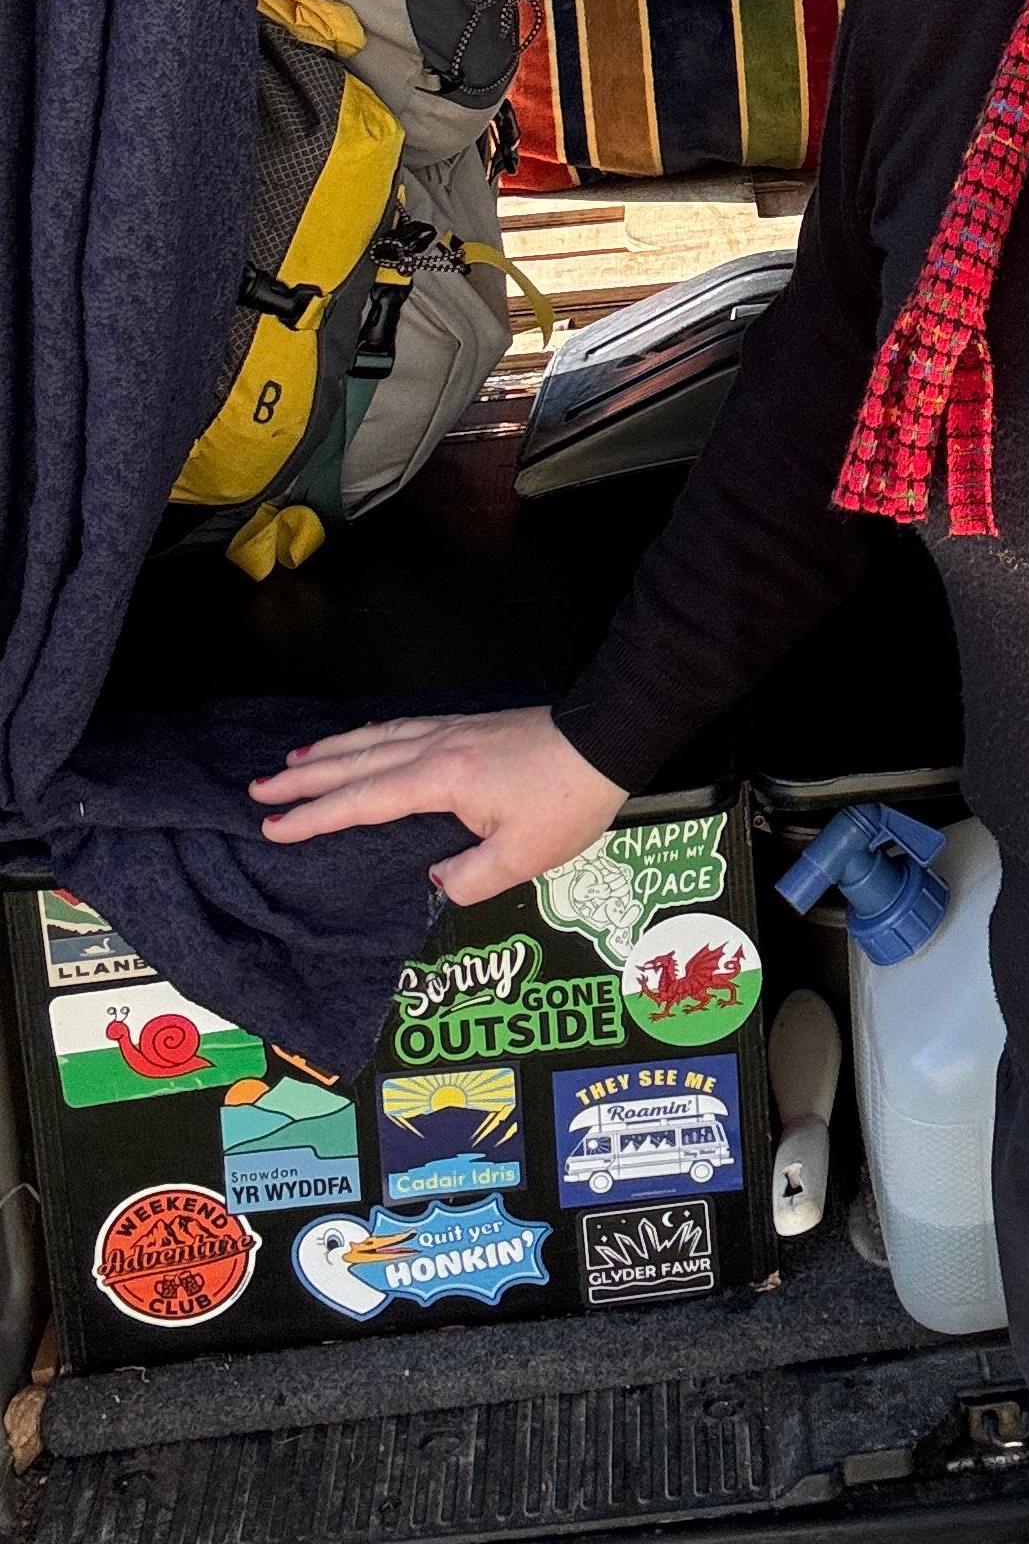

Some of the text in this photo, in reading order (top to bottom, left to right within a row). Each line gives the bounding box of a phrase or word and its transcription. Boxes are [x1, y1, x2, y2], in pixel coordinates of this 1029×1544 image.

[613, 817, 714, 859] HAPPY
[643, 845, 704, 866] WITH MY
[634, 866, 713, 904] PACE
[58, 958, 148, 979] LLANB
[398, 942, 526, 1017] Sorry
[522, 981, 613, 1011] GONE
[401, 1007, 618, 1058] OUTSIDE
[576, 1070, 716, 1106] THEY SEE ME
[607, 1100, 692, 1121] Roamin'
[231, 1167, 298, 1183] Snowdon
[397, 1166, 515, 1194] Cadair Idris
[232, 1175, 352, 1206] YR WYDDFA
[116, 1196, 228, 1237] WEEKEND
[418, 1221, 502, 1247] Quit yer
[97, 1234, 256, 1276] Adventure
[386, 1230, 534, 1288] HONKIN'
[589, 1258, 711, 1285] GLYDER FAWR
[149, 1294, 212, 1315] CLUB
